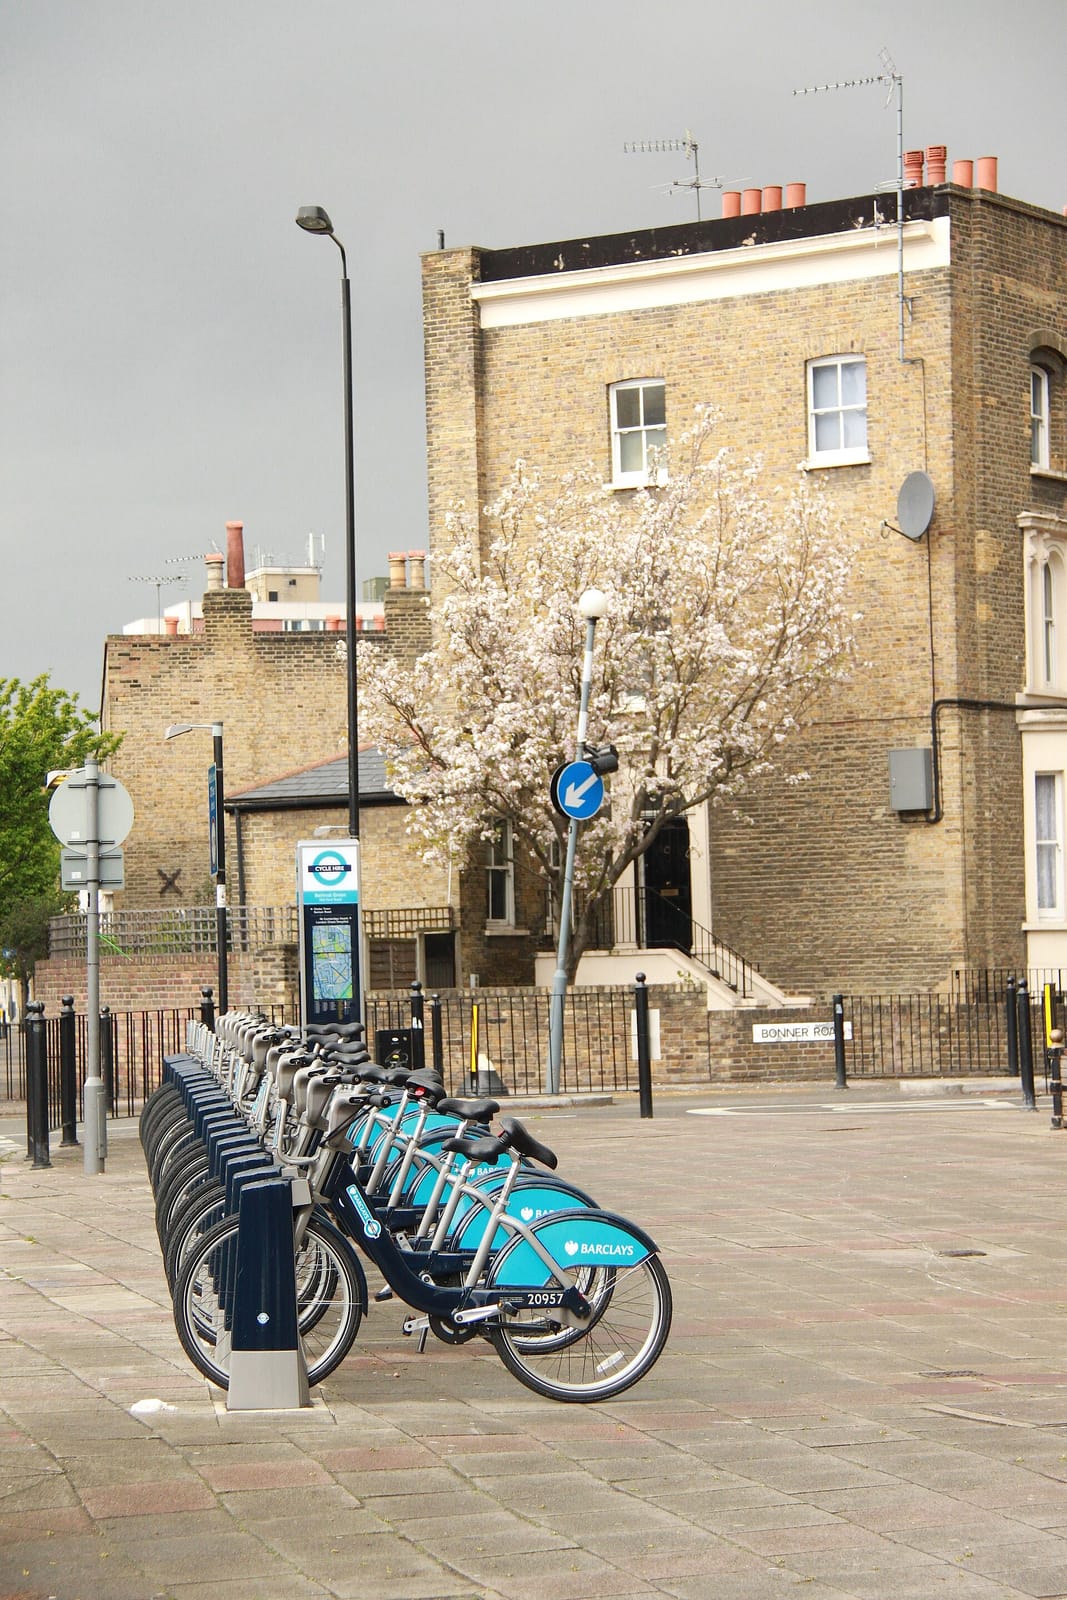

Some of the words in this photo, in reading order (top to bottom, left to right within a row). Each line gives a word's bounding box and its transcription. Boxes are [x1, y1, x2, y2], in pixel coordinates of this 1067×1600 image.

[761, 1027, 808, 1039] BONNER
[813, 1026, 835, 1037] ROA
[580, 1243, 634, 1256] BARCLAYS
[527, 1293, 564, 1305] 20957
